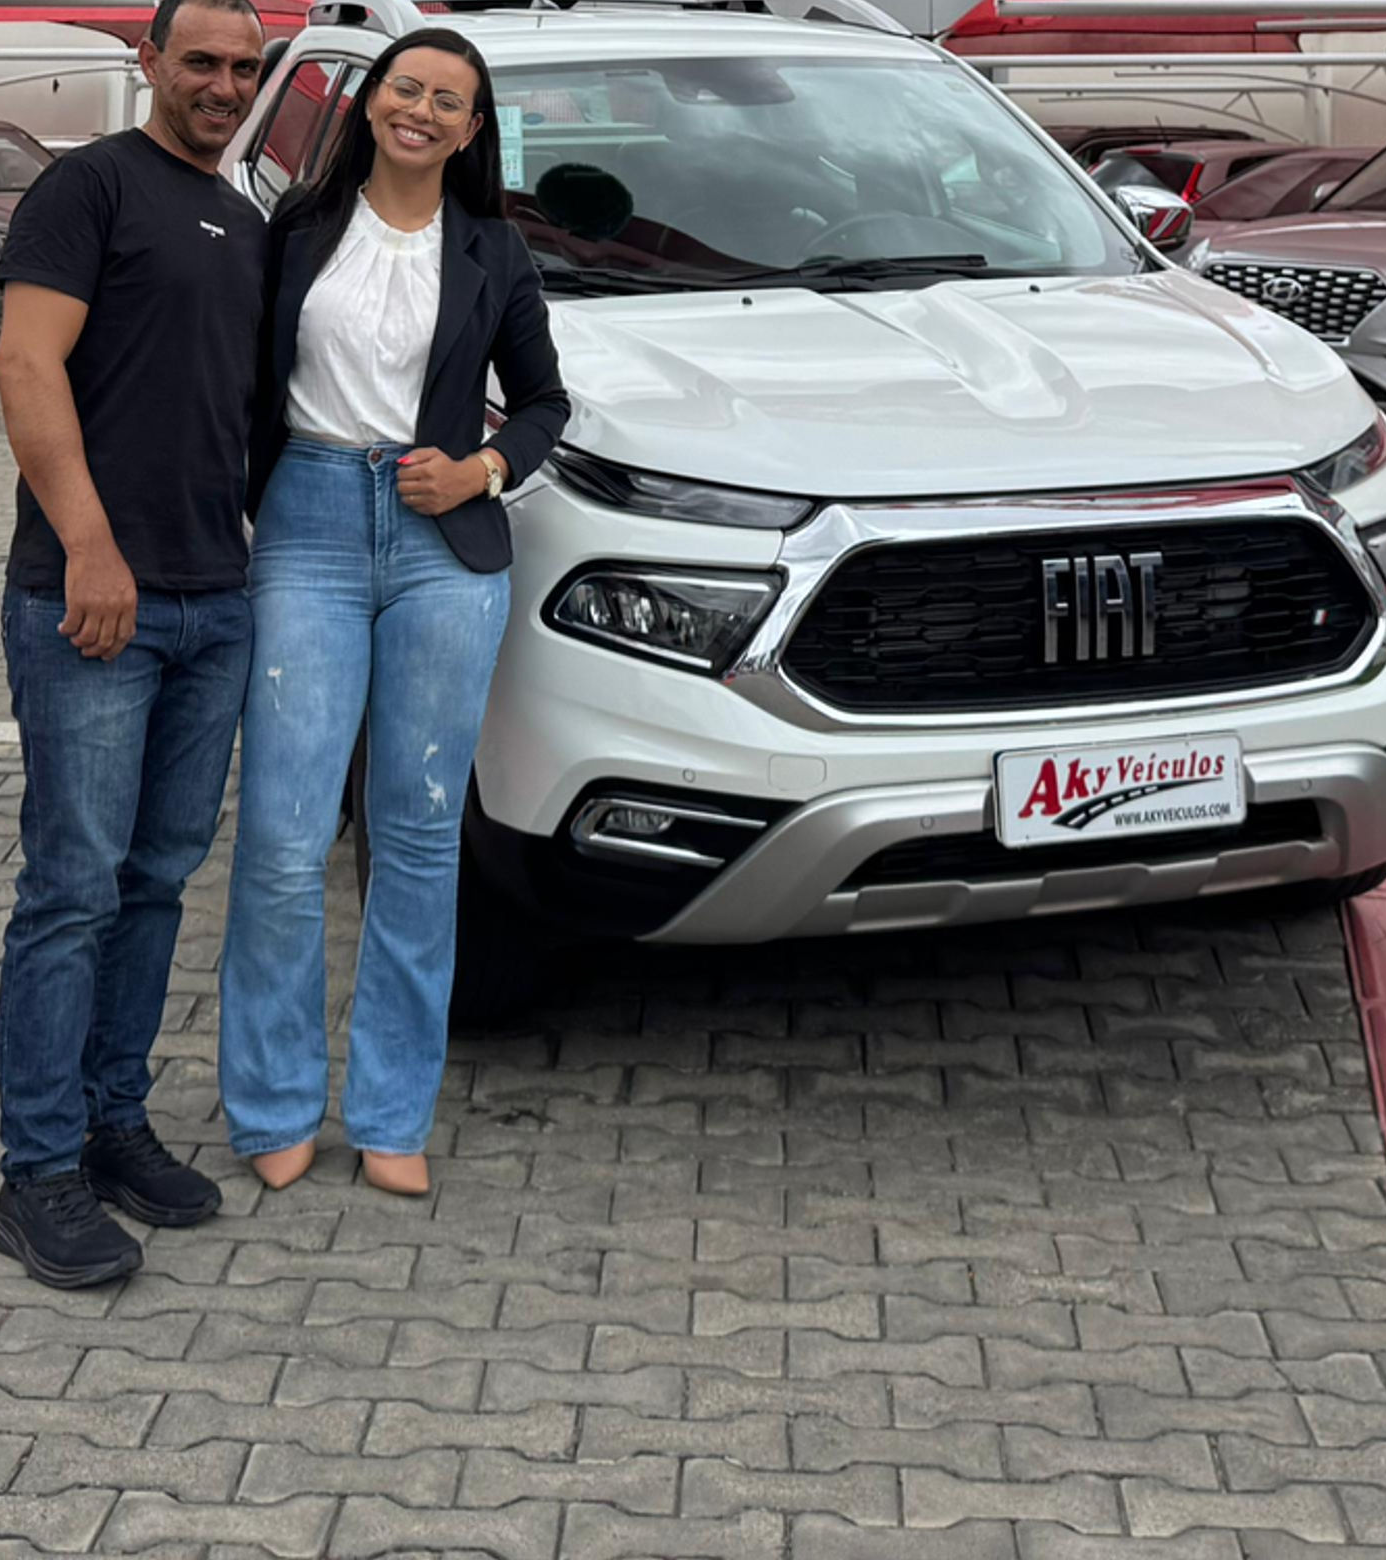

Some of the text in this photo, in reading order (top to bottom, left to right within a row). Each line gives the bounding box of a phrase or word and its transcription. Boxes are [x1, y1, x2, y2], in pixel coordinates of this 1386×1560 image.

[1042, 551, 1163, 663] FIAT
[1018, 758, 1112, 819] Aky
[1116, 751, 1226, 783] Veículos
